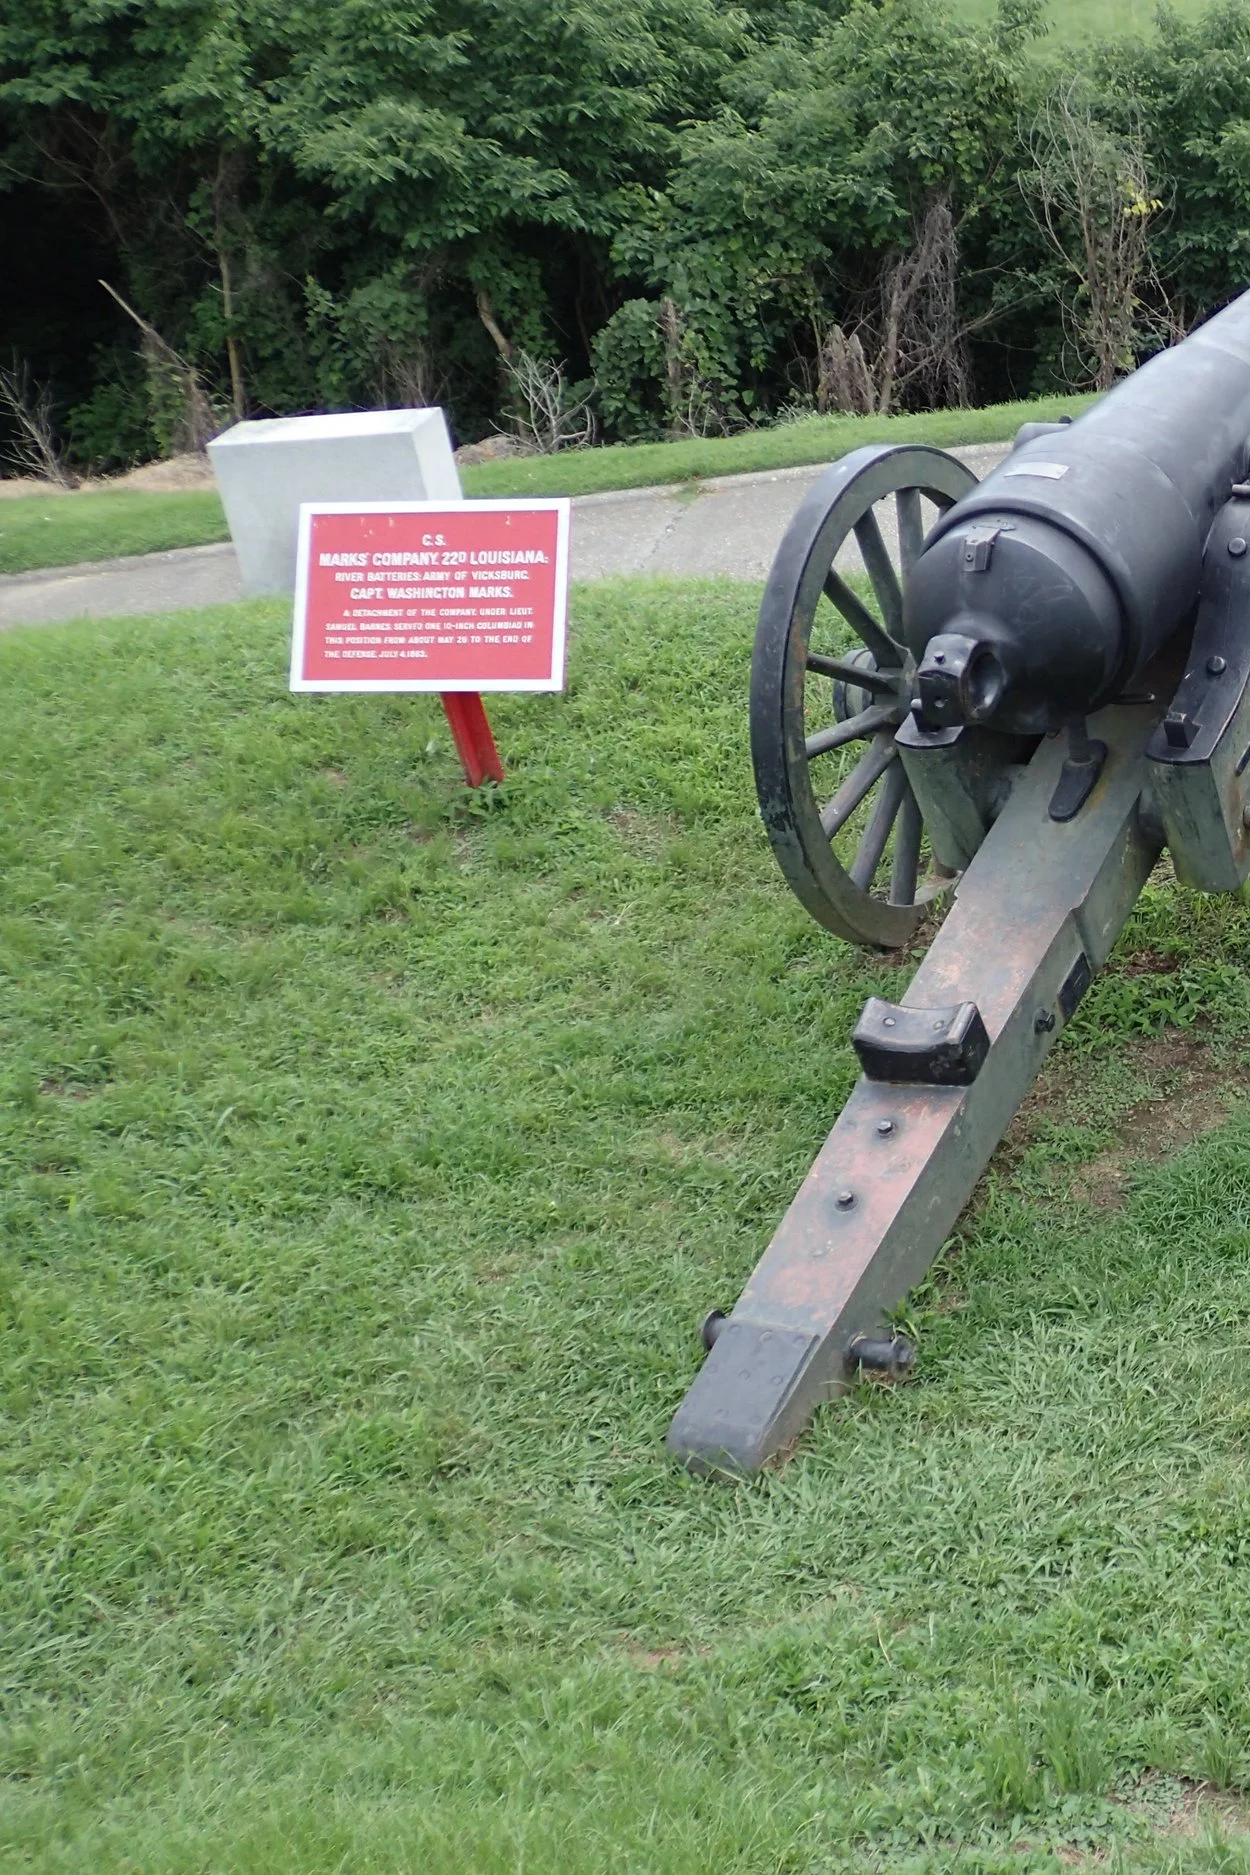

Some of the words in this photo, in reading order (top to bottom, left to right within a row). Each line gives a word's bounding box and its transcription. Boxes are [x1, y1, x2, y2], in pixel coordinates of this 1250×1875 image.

[335, 572, 364, 582] RIVER
[422, 571, 450, 580] ARMY
[454, 571, 467, 580] OF
[387, 587, 465, 599] WASHINGTON
[468, 586, 513, 598] MARKS.
